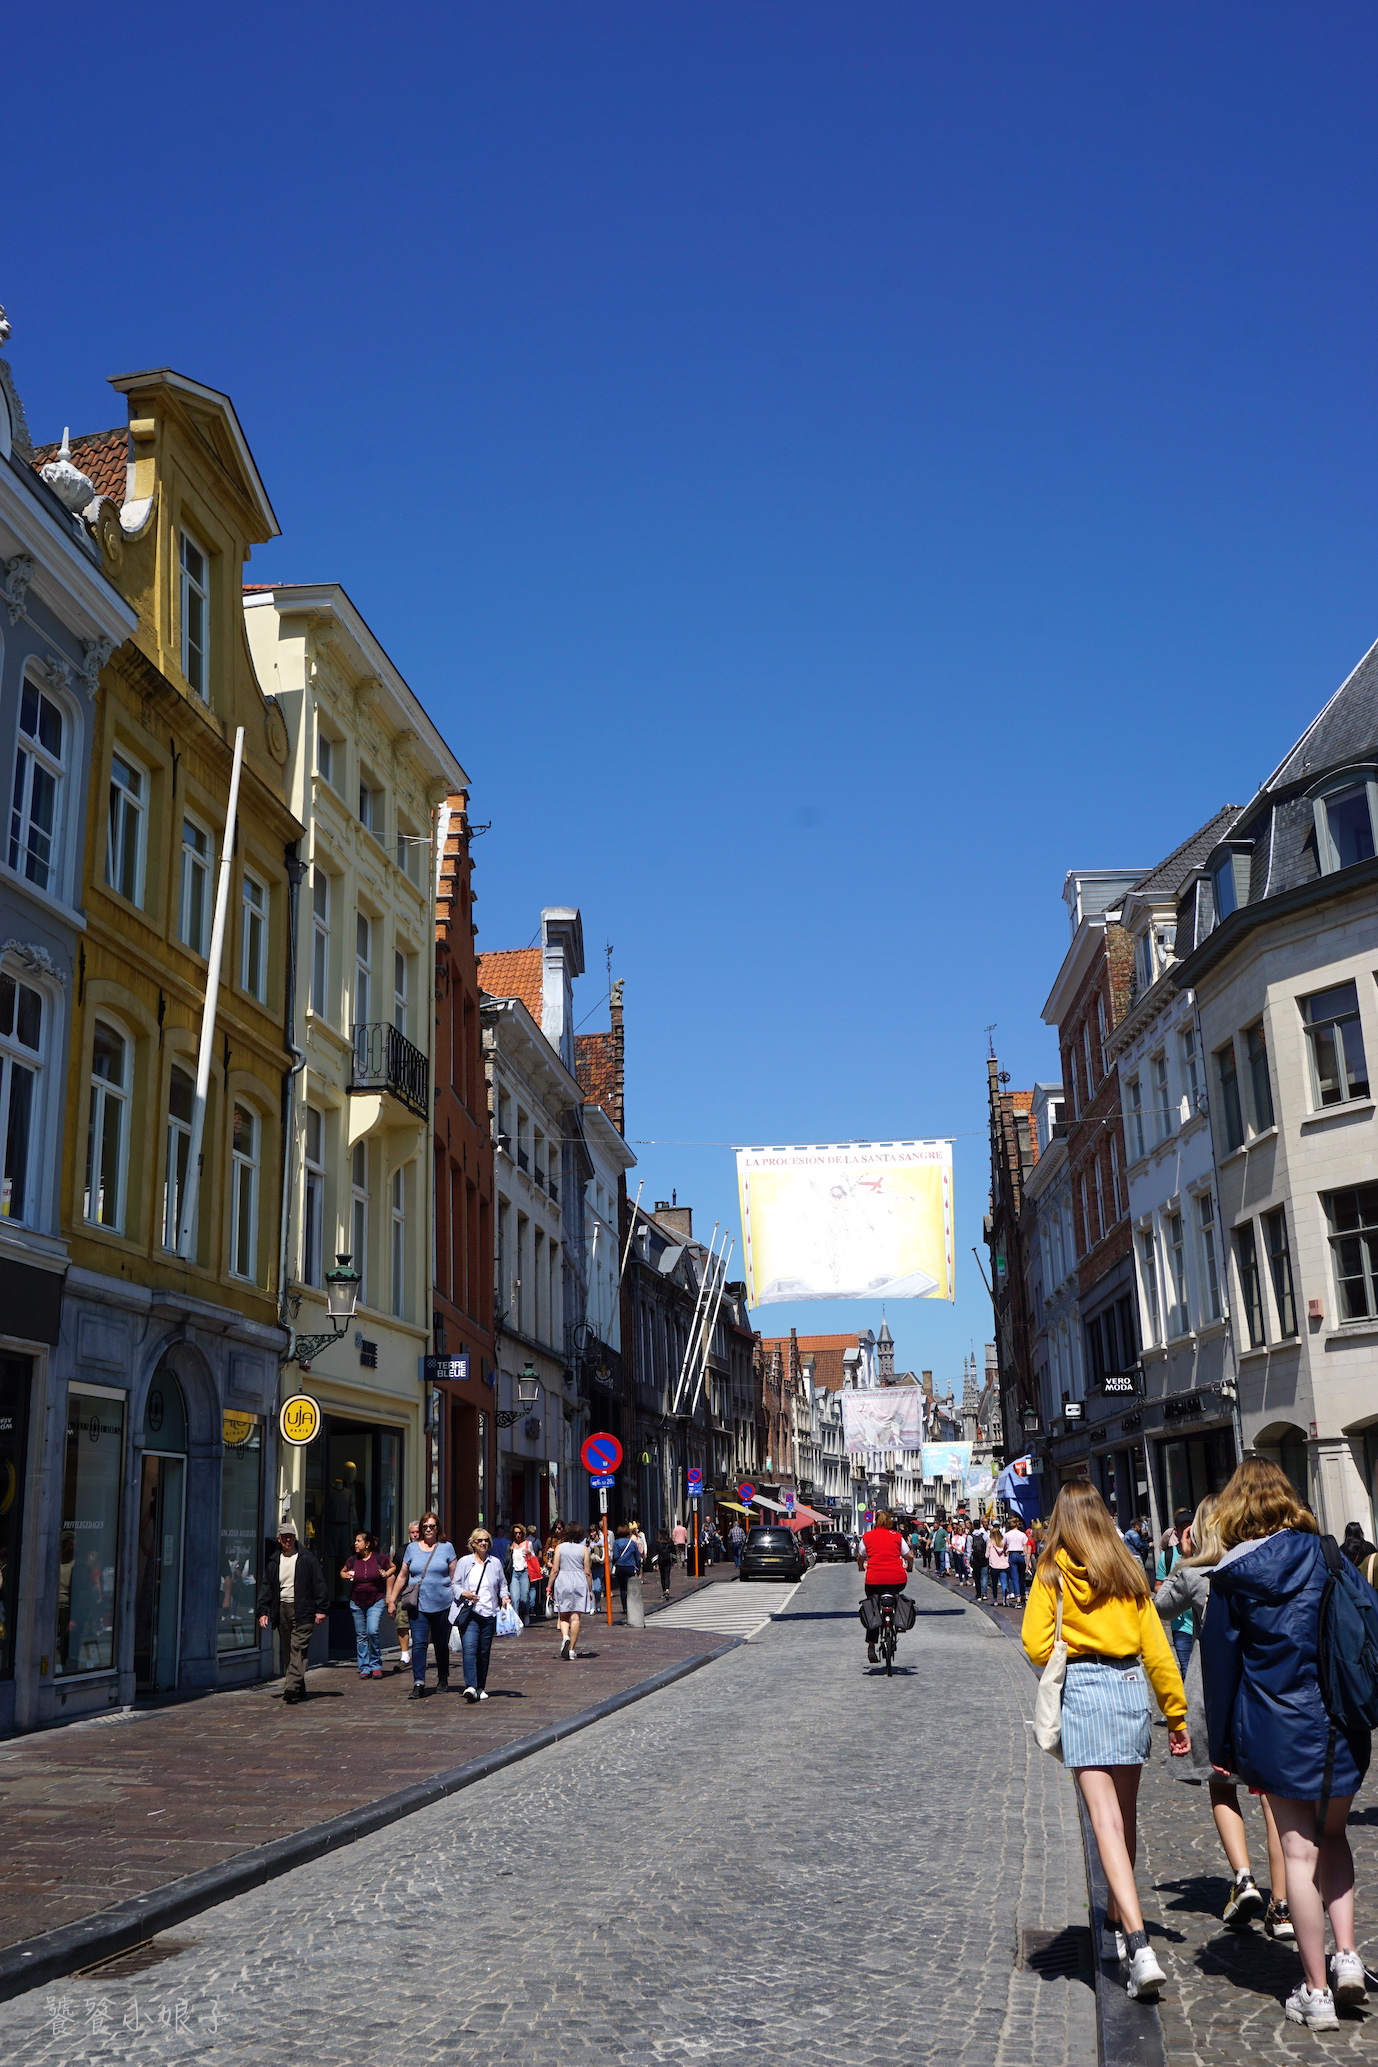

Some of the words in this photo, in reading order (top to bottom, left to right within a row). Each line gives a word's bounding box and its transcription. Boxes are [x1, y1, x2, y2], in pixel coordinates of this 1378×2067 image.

[746, 1158, 759, 1166] LA
[762, 1155, 824, 1166] PROCESIÓN
[828, 1156, 843, 1164] DE
[845, 1155, 859, 1164] LA
[861, 1153, 896, 1163] SANTA
[898, 1151, 943, 1161] SANGRE
[437, 1360, 466, 1369] TERRE
[437, 1369, 466, 1378] BLEUE
[1105, 1377, 1131, 1385] VERO
